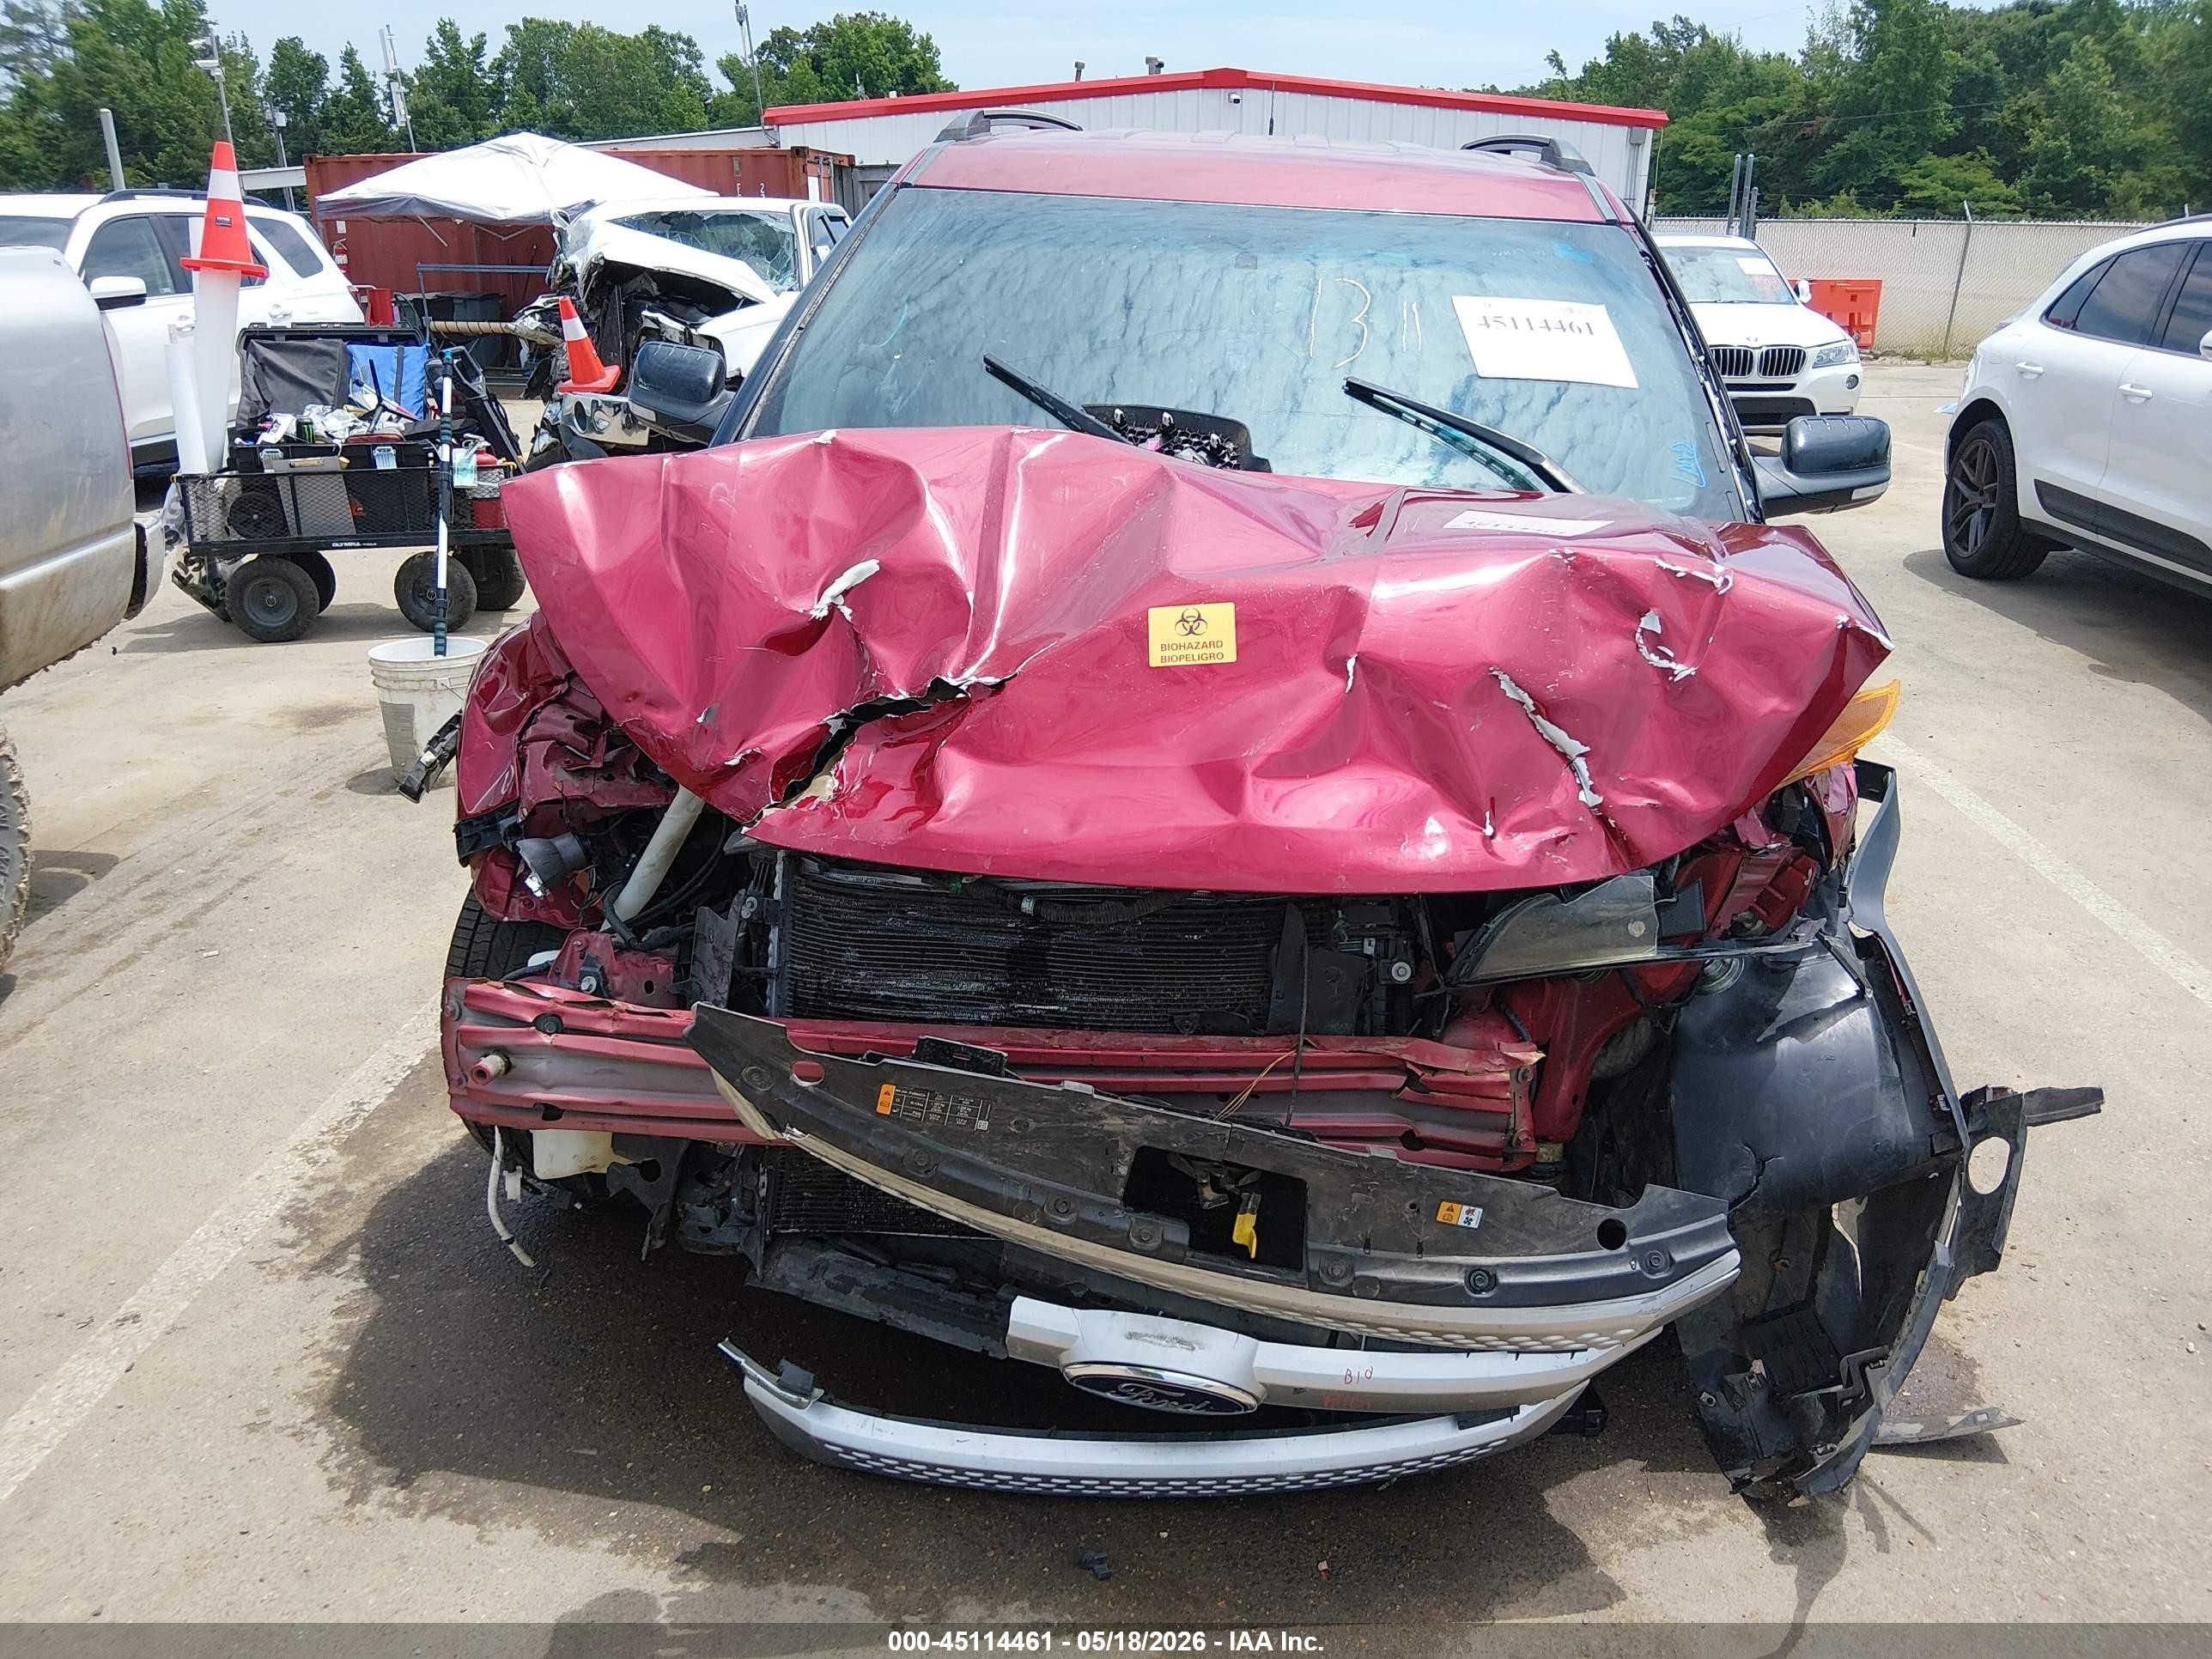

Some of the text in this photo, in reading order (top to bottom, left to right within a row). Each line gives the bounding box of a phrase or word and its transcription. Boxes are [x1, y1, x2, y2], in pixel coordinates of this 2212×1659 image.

[1160, 641, 1223, 651] BIOHAZARD
[1160, 653, 1224, 663] BIOPELIGRO
[1105, 1382, 1212, 1412] Ford
